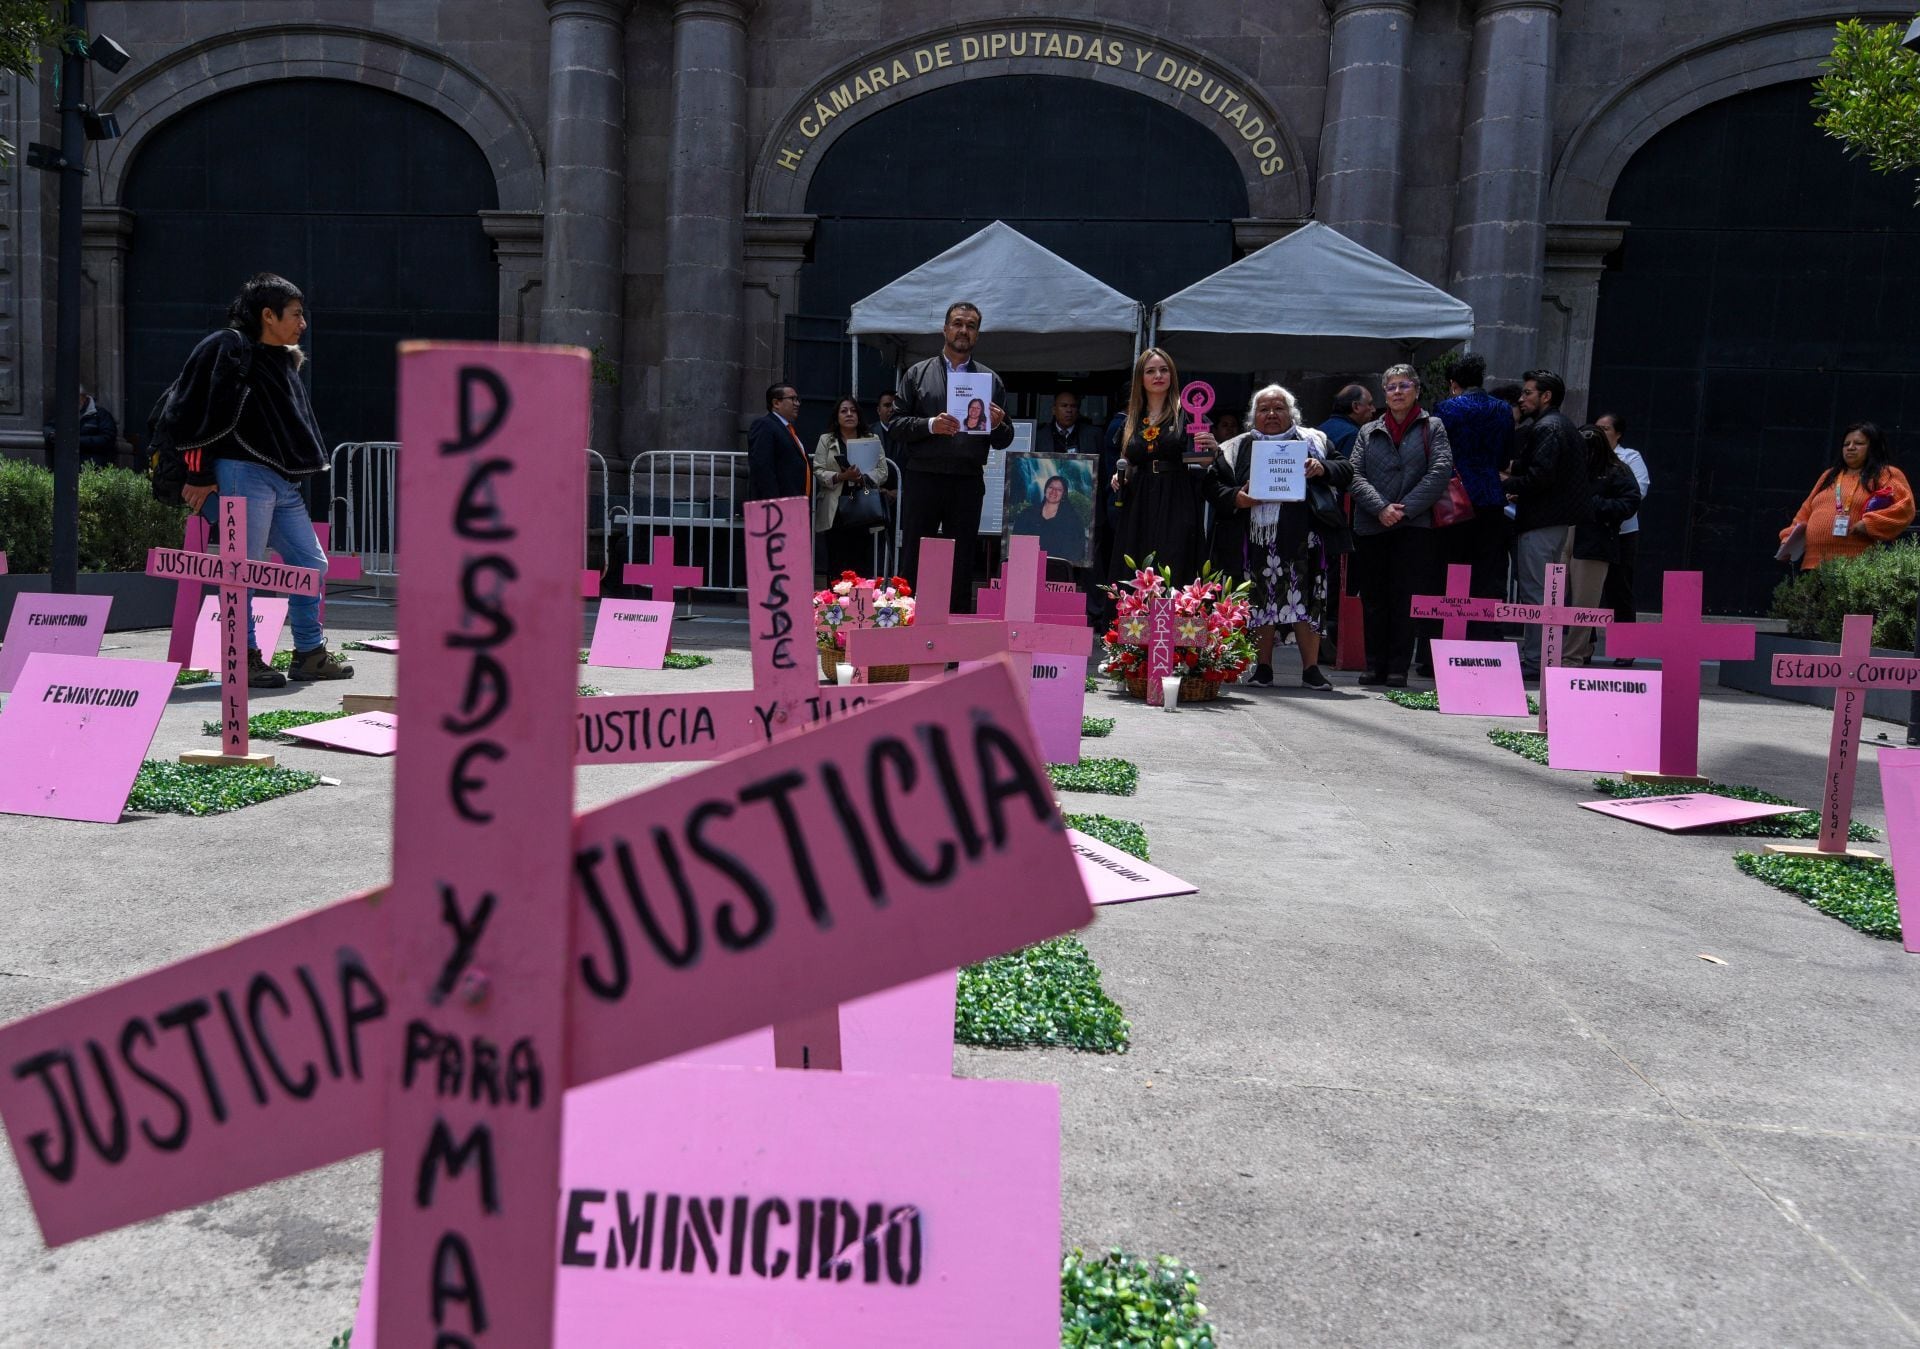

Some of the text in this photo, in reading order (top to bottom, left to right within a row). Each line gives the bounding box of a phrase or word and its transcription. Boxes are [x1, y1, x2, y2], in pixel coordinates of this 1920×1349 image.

[776, 31, 1284, 176] H. CÁMARA DE DIPUTADAS Y DIPUTADOS
[1269, 466, 1293, 474] MARIANA
[226, 501, 237, 552] PARA
[156, 552, 312, 591] JUSTICIA Y JUSTICIA
[437, 364, 518, 825] DESDE
[750, 502, 798, 670] DESDE
[28, 613, 88, 628] FEMINICIDIO
[613, 612, 658, 623] FEMINICIDIO
[1153, 598, 1172, 674] MARIANA
[1496, 605, 1541, 620] ESTADO
[1573, 610, 1614, 625] México
[226, 591, 240, 745] MARIANA LIMA
[1448, 657, 1502, 668] FEMINICIDIO
[1570, 679, 1648, 694] FEMINICIDIO
[1856, 662, 1920, 684] Corrup
[42, 684, 140, 708] FEMINICIDIO
[577, 705, 716, 754] USTICIA
[755, 700, 778, 743] Y
[575, 706, 1062, 1002] JUSTICIA
[436, 879, 498, 1006] Y
[11, 946, 389, 1185] JUSTICIA
[402, 1019, 544, 1110] PARA
[559, 1188, 923, 1286] EMINICIDIO
